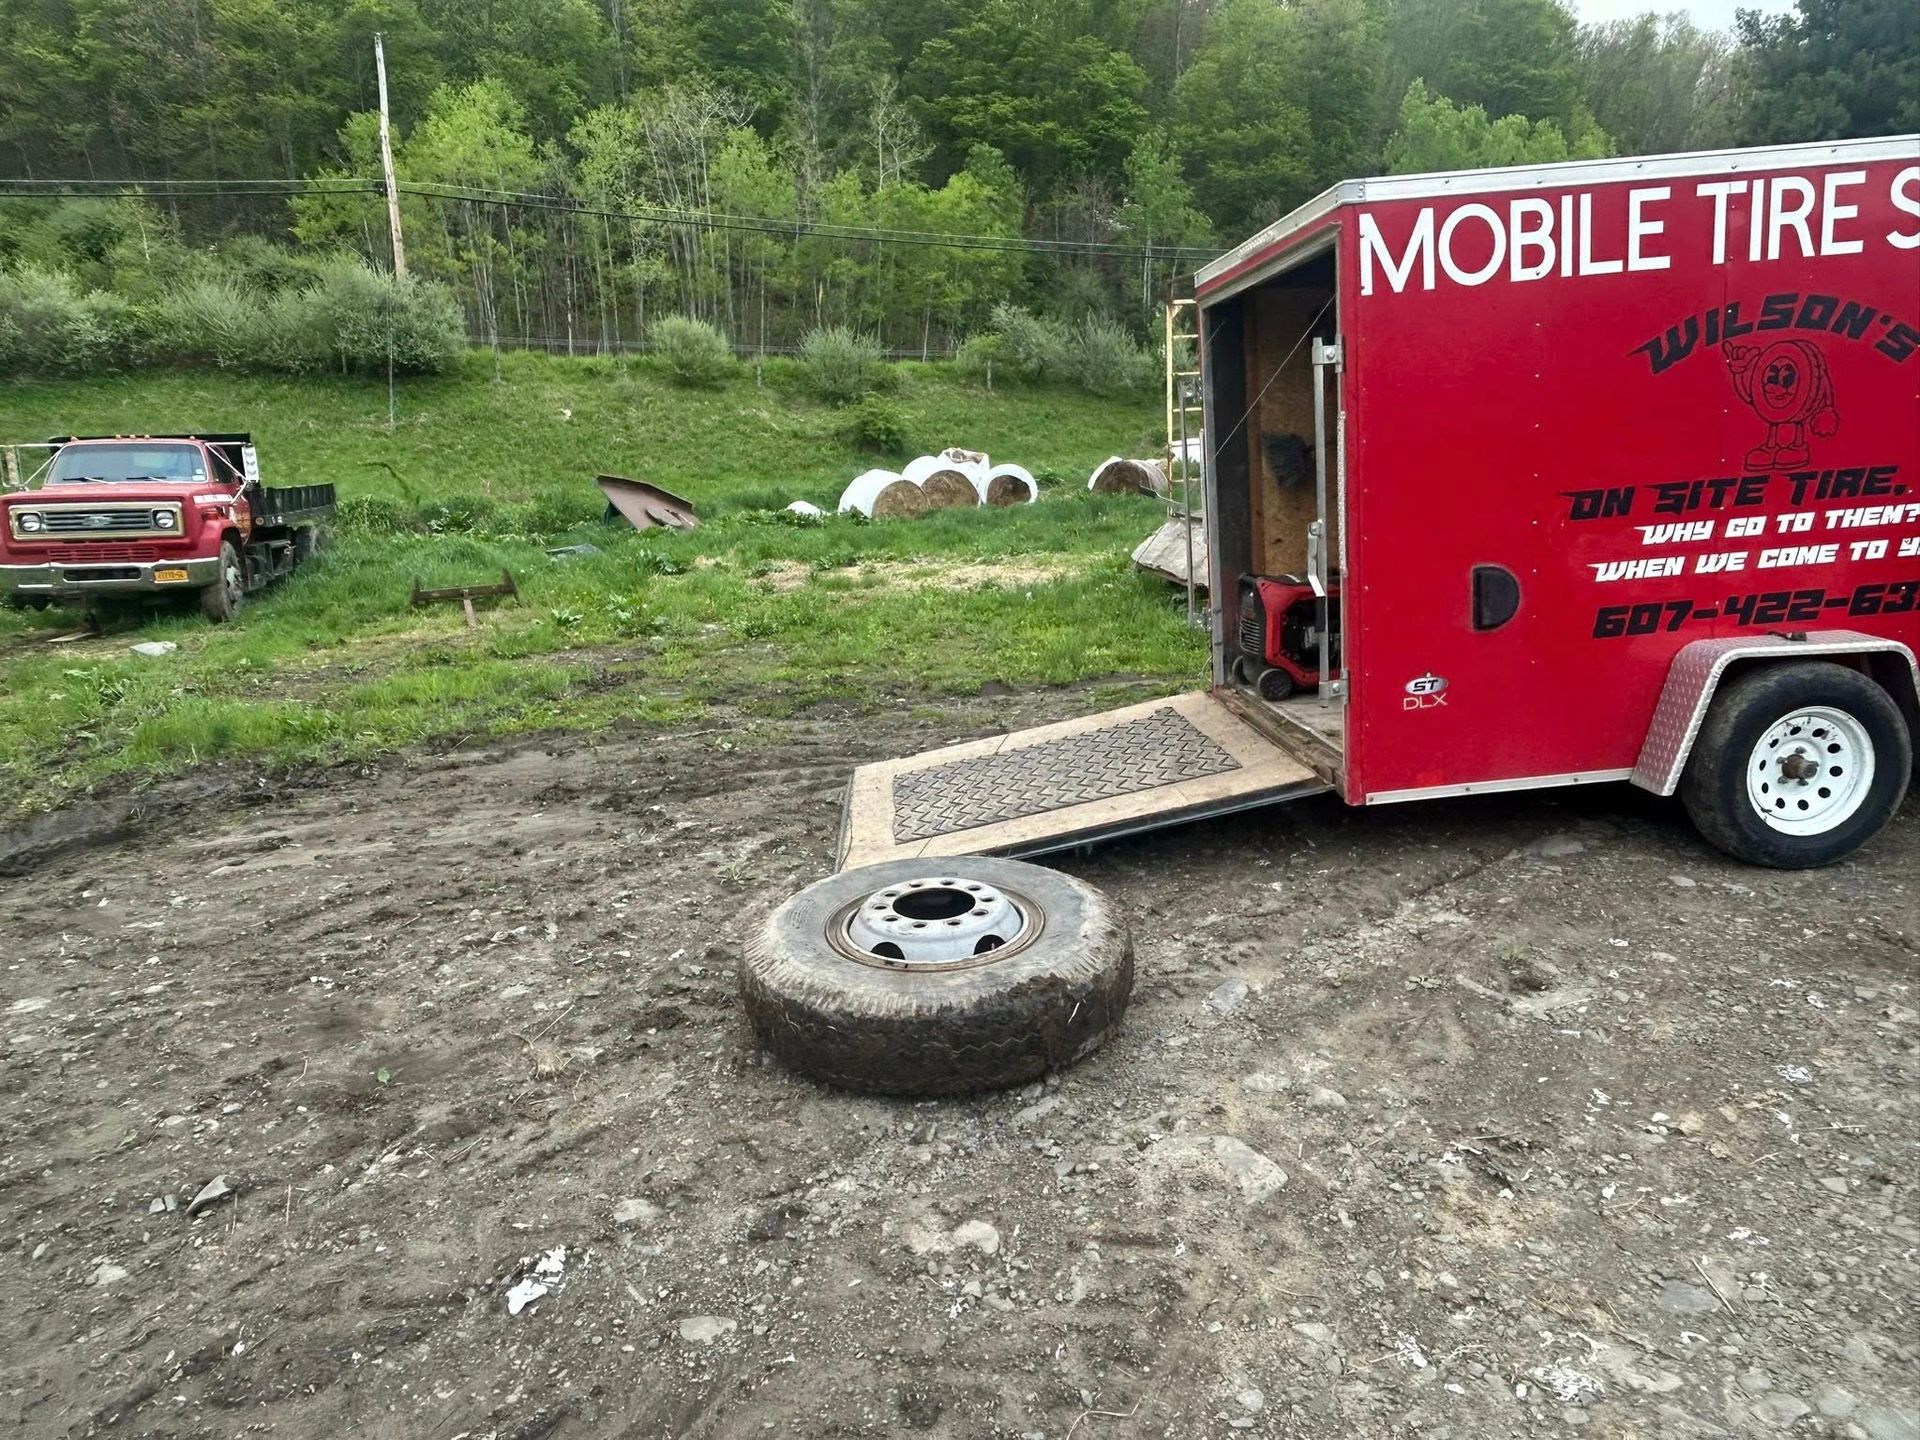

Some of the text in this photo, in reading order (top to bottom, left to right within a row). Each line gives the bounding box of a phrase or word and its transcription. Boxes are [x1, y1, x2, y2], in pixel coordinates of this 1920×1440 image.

[1360, 186, 1671, 296] MOBILE
[1697, 170, 1866, 265] TIRE
[1626, 293, 1920, 375] WILSON'S
[1559, 486, 1635, 520] ON
[1645, 475, 1770, 515] SITE
[1633, 503, 1920, 545] WHY GO TO THEM?
[1587, 556, 1685, 583] WHEN
[1695, 552, 1748, 575] WE
[1757, 544, 1840, 569] COME
[1849, 540, 1889, 562] TO
[1592, 580, 1920, 639] 607-422-63
[1403, 693, 1448, 711] DLX
[1412, 679, 1439, 692] ST
